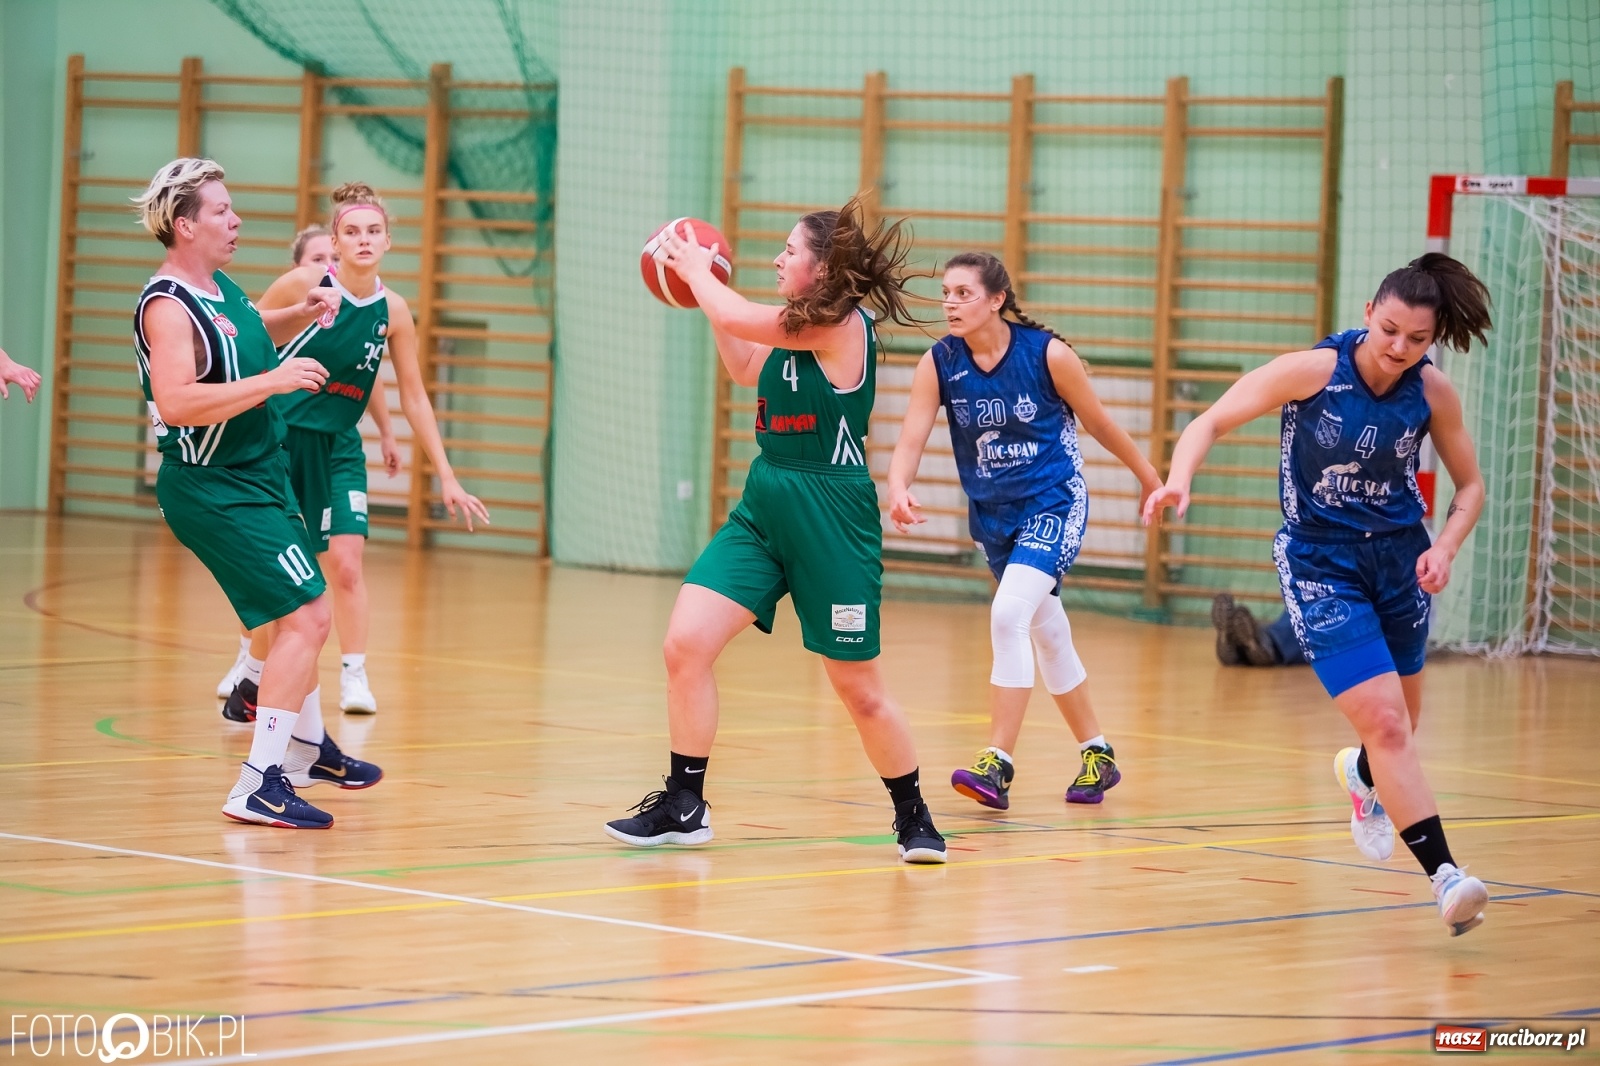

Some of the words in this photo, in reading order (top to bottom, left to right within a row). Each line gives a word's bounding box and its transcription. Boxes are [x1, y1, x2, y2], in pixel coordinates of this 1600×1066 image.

[782, 353, 799, 392] 4
[1325, 383, 1353, 393] egio
[976, 398, 1007, 428] 20
[1355, 425, 1378, 459] 4
[277, 543, 315, 586] 10
